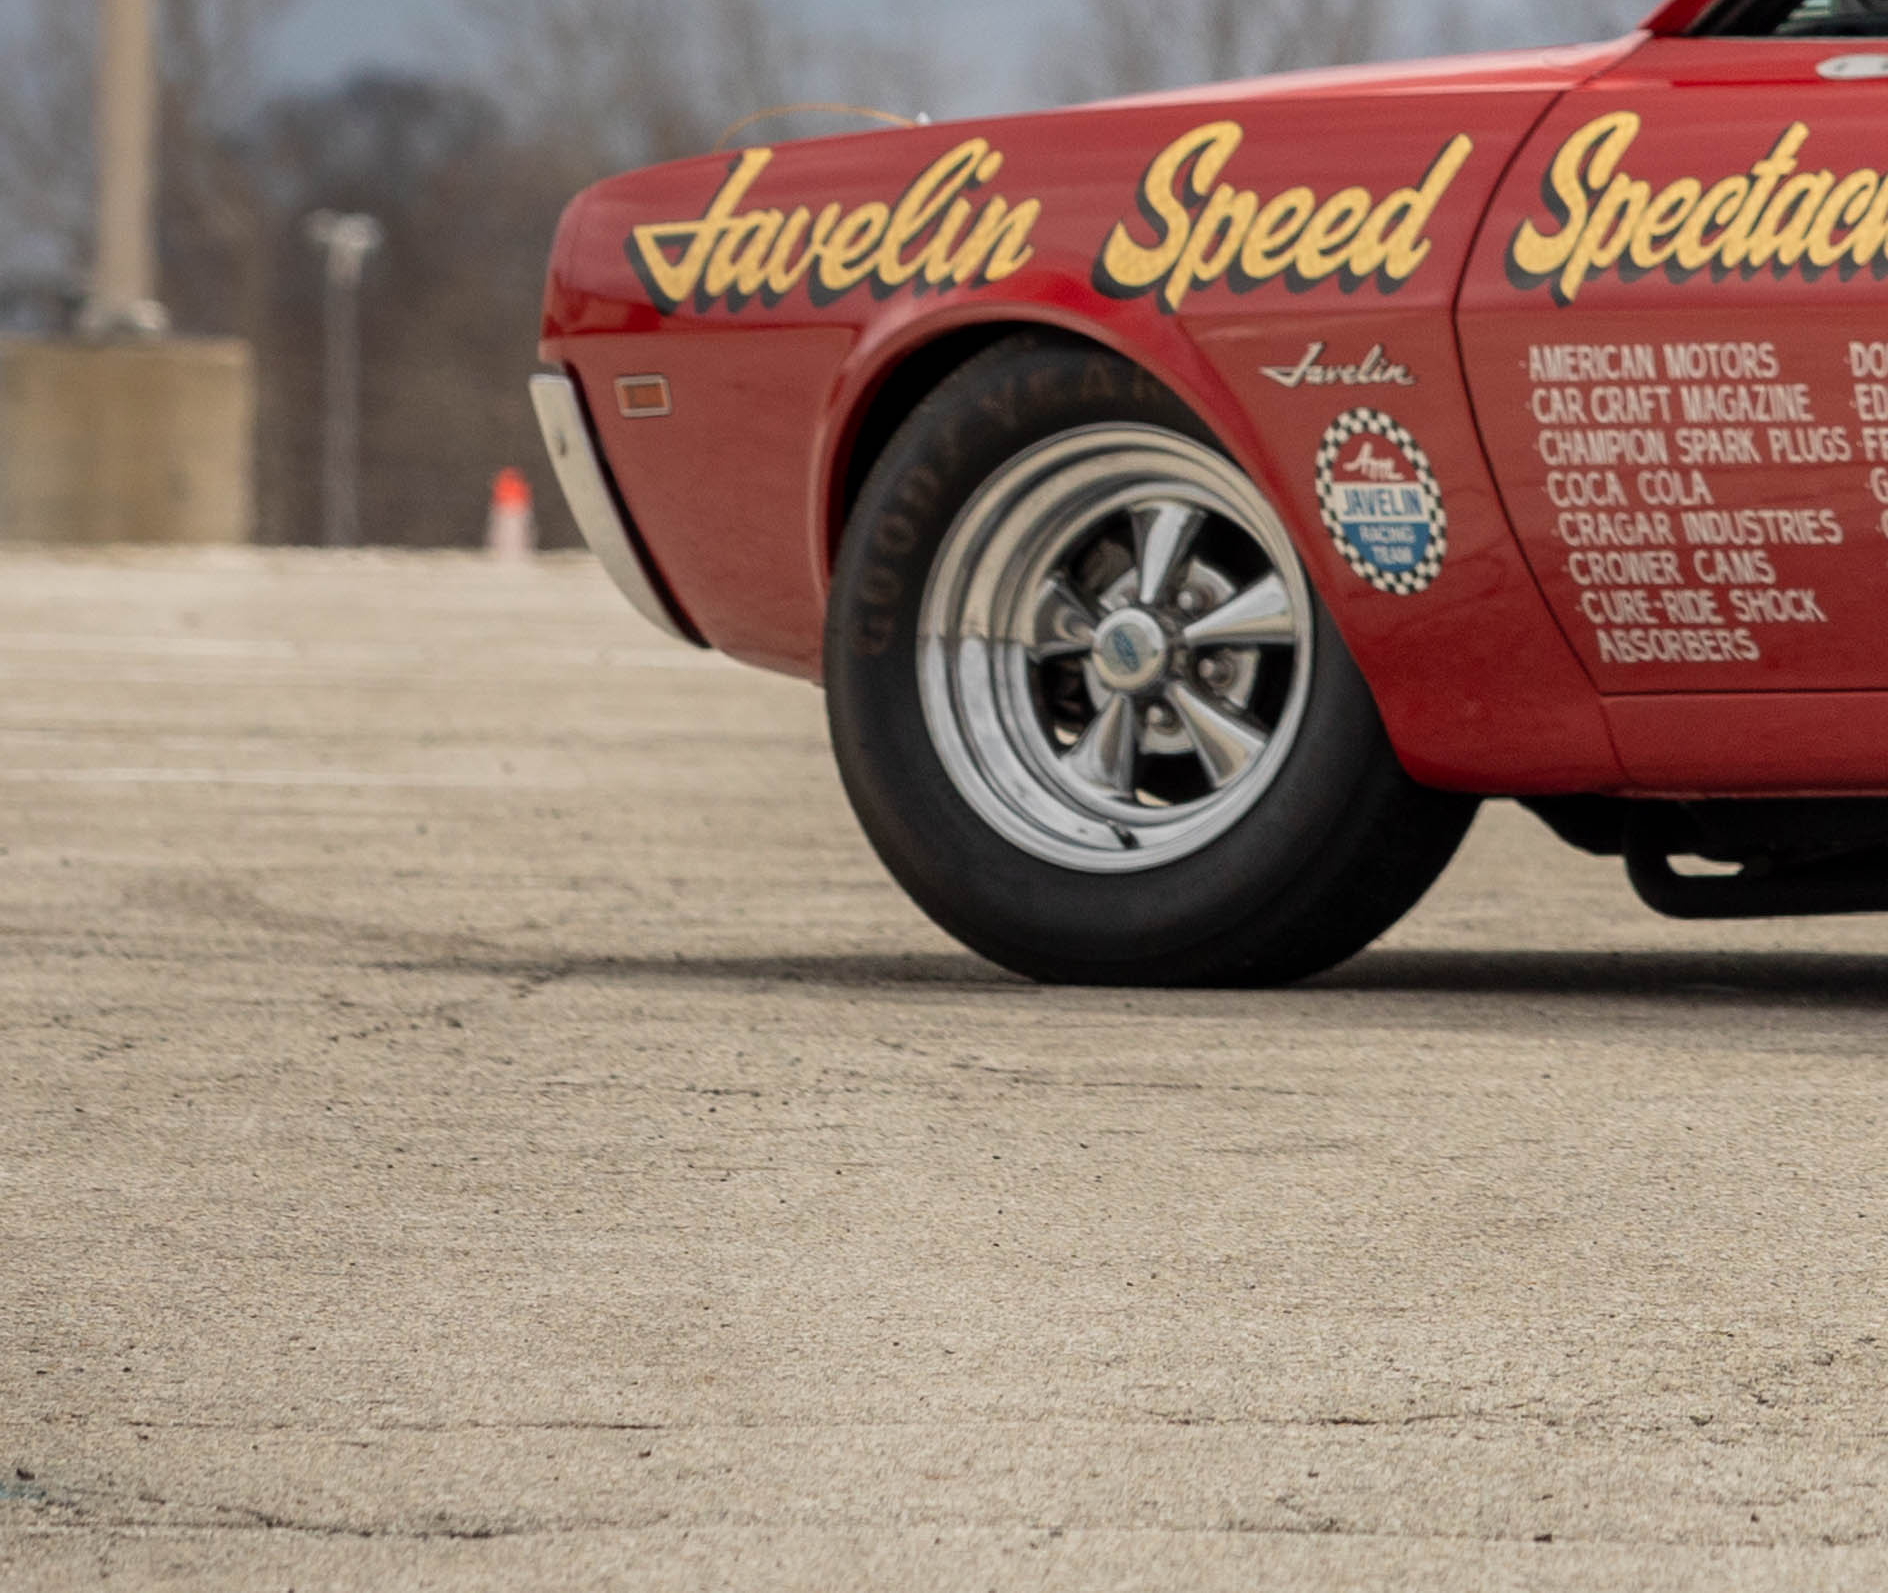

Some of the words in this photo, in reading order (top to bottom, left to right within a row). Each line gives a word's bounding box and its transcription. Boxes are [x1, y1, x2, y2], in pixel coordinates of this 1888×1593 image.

[628, 136, 1041, 313] Javelin
[1093, 120, 1473, 314] Speed
[1258, 340, 1417, 388] Javelin
[1529, 345, 1656, 381] AMERICAN
[1663, 342, 1779, 379] MOTORS
[1532, 387, 1589, 423] CAR
[1590, 386, 1671, 423] CRAFT
[1680, 384, 1814, 422] MAGAZINE
[1538, 428, 1669, 465] CHAMPION
[1675, 427, 1761, 464] SPARK
[1767, 427, 1851, 463] PLUGS
[1343, 487, 1424, 516] JAVELIN
[1547, 470, 1628, 507] COCA
[1637, 470, 1714, 505] COLA
[1558, 511, 1676, 547] CRAGAR
[1681, 509, 1843, 545] INDUSTRIES
[1568, 551, 1684, 585] CROWER
[1693, 550, 1776, 585] CAMS
[1581, 590, 1725, 625] CURE-RIDE
[1729, 589, 1827, 623] SHOCK
[1596, 628, 1760, 663] ABSORBERS
